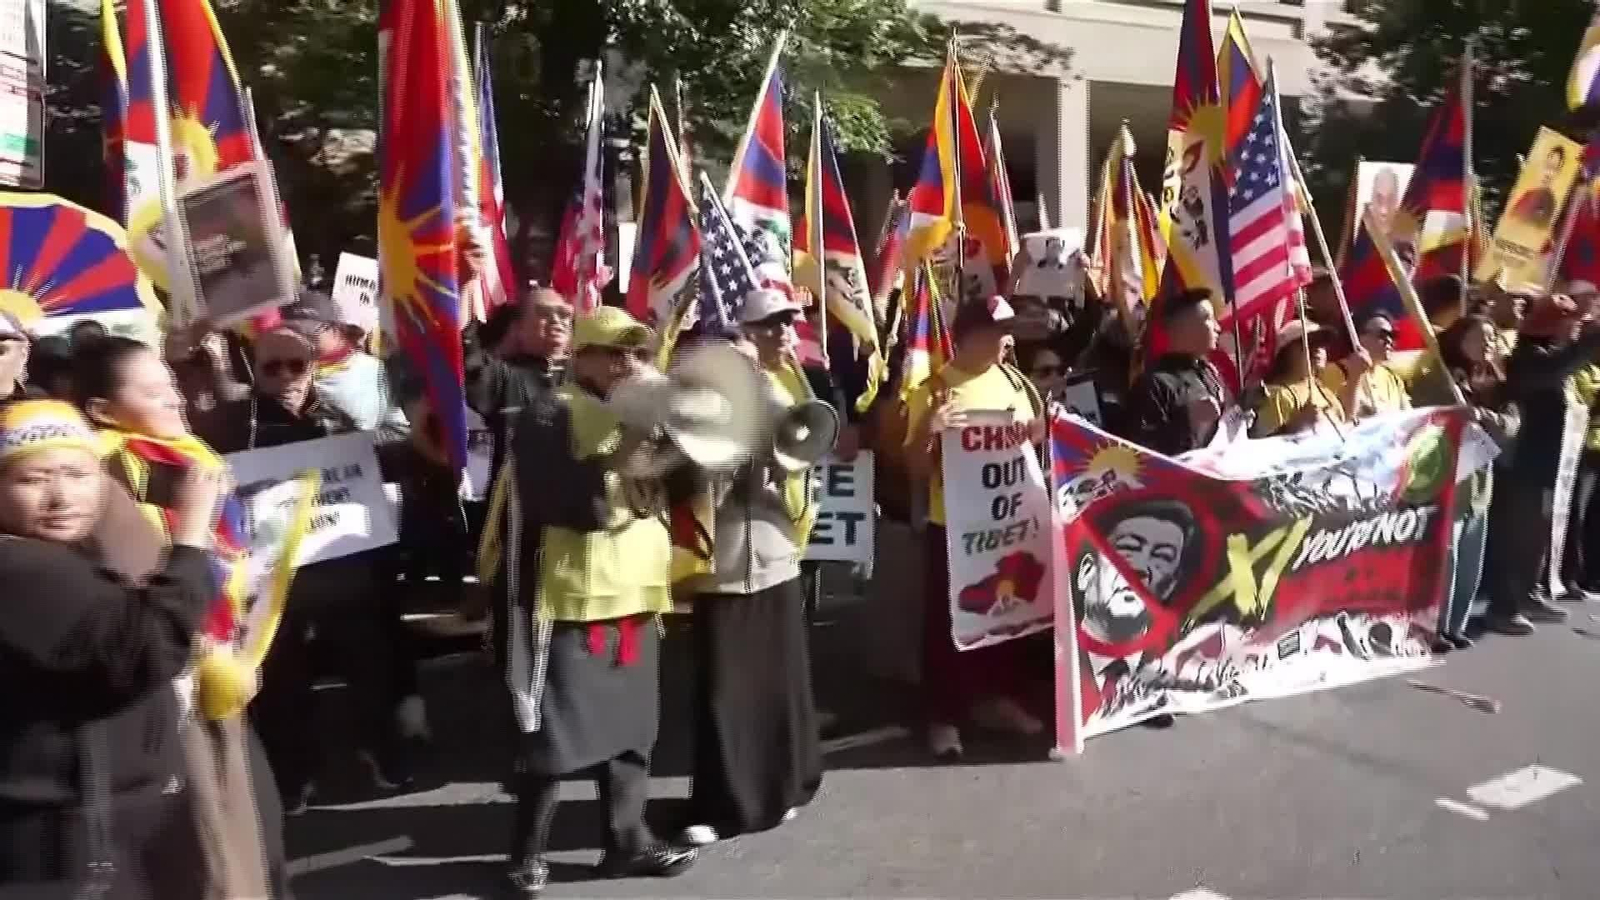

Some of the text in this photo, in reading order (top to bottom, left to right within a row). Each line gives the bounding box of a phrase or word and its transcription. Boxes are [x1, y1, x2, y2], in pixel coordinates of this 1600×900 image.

[982, 456, 1026, 489] OUT
[991, 492, 1023, 521] OF
[1372, 506, 1438, 545] NOT
